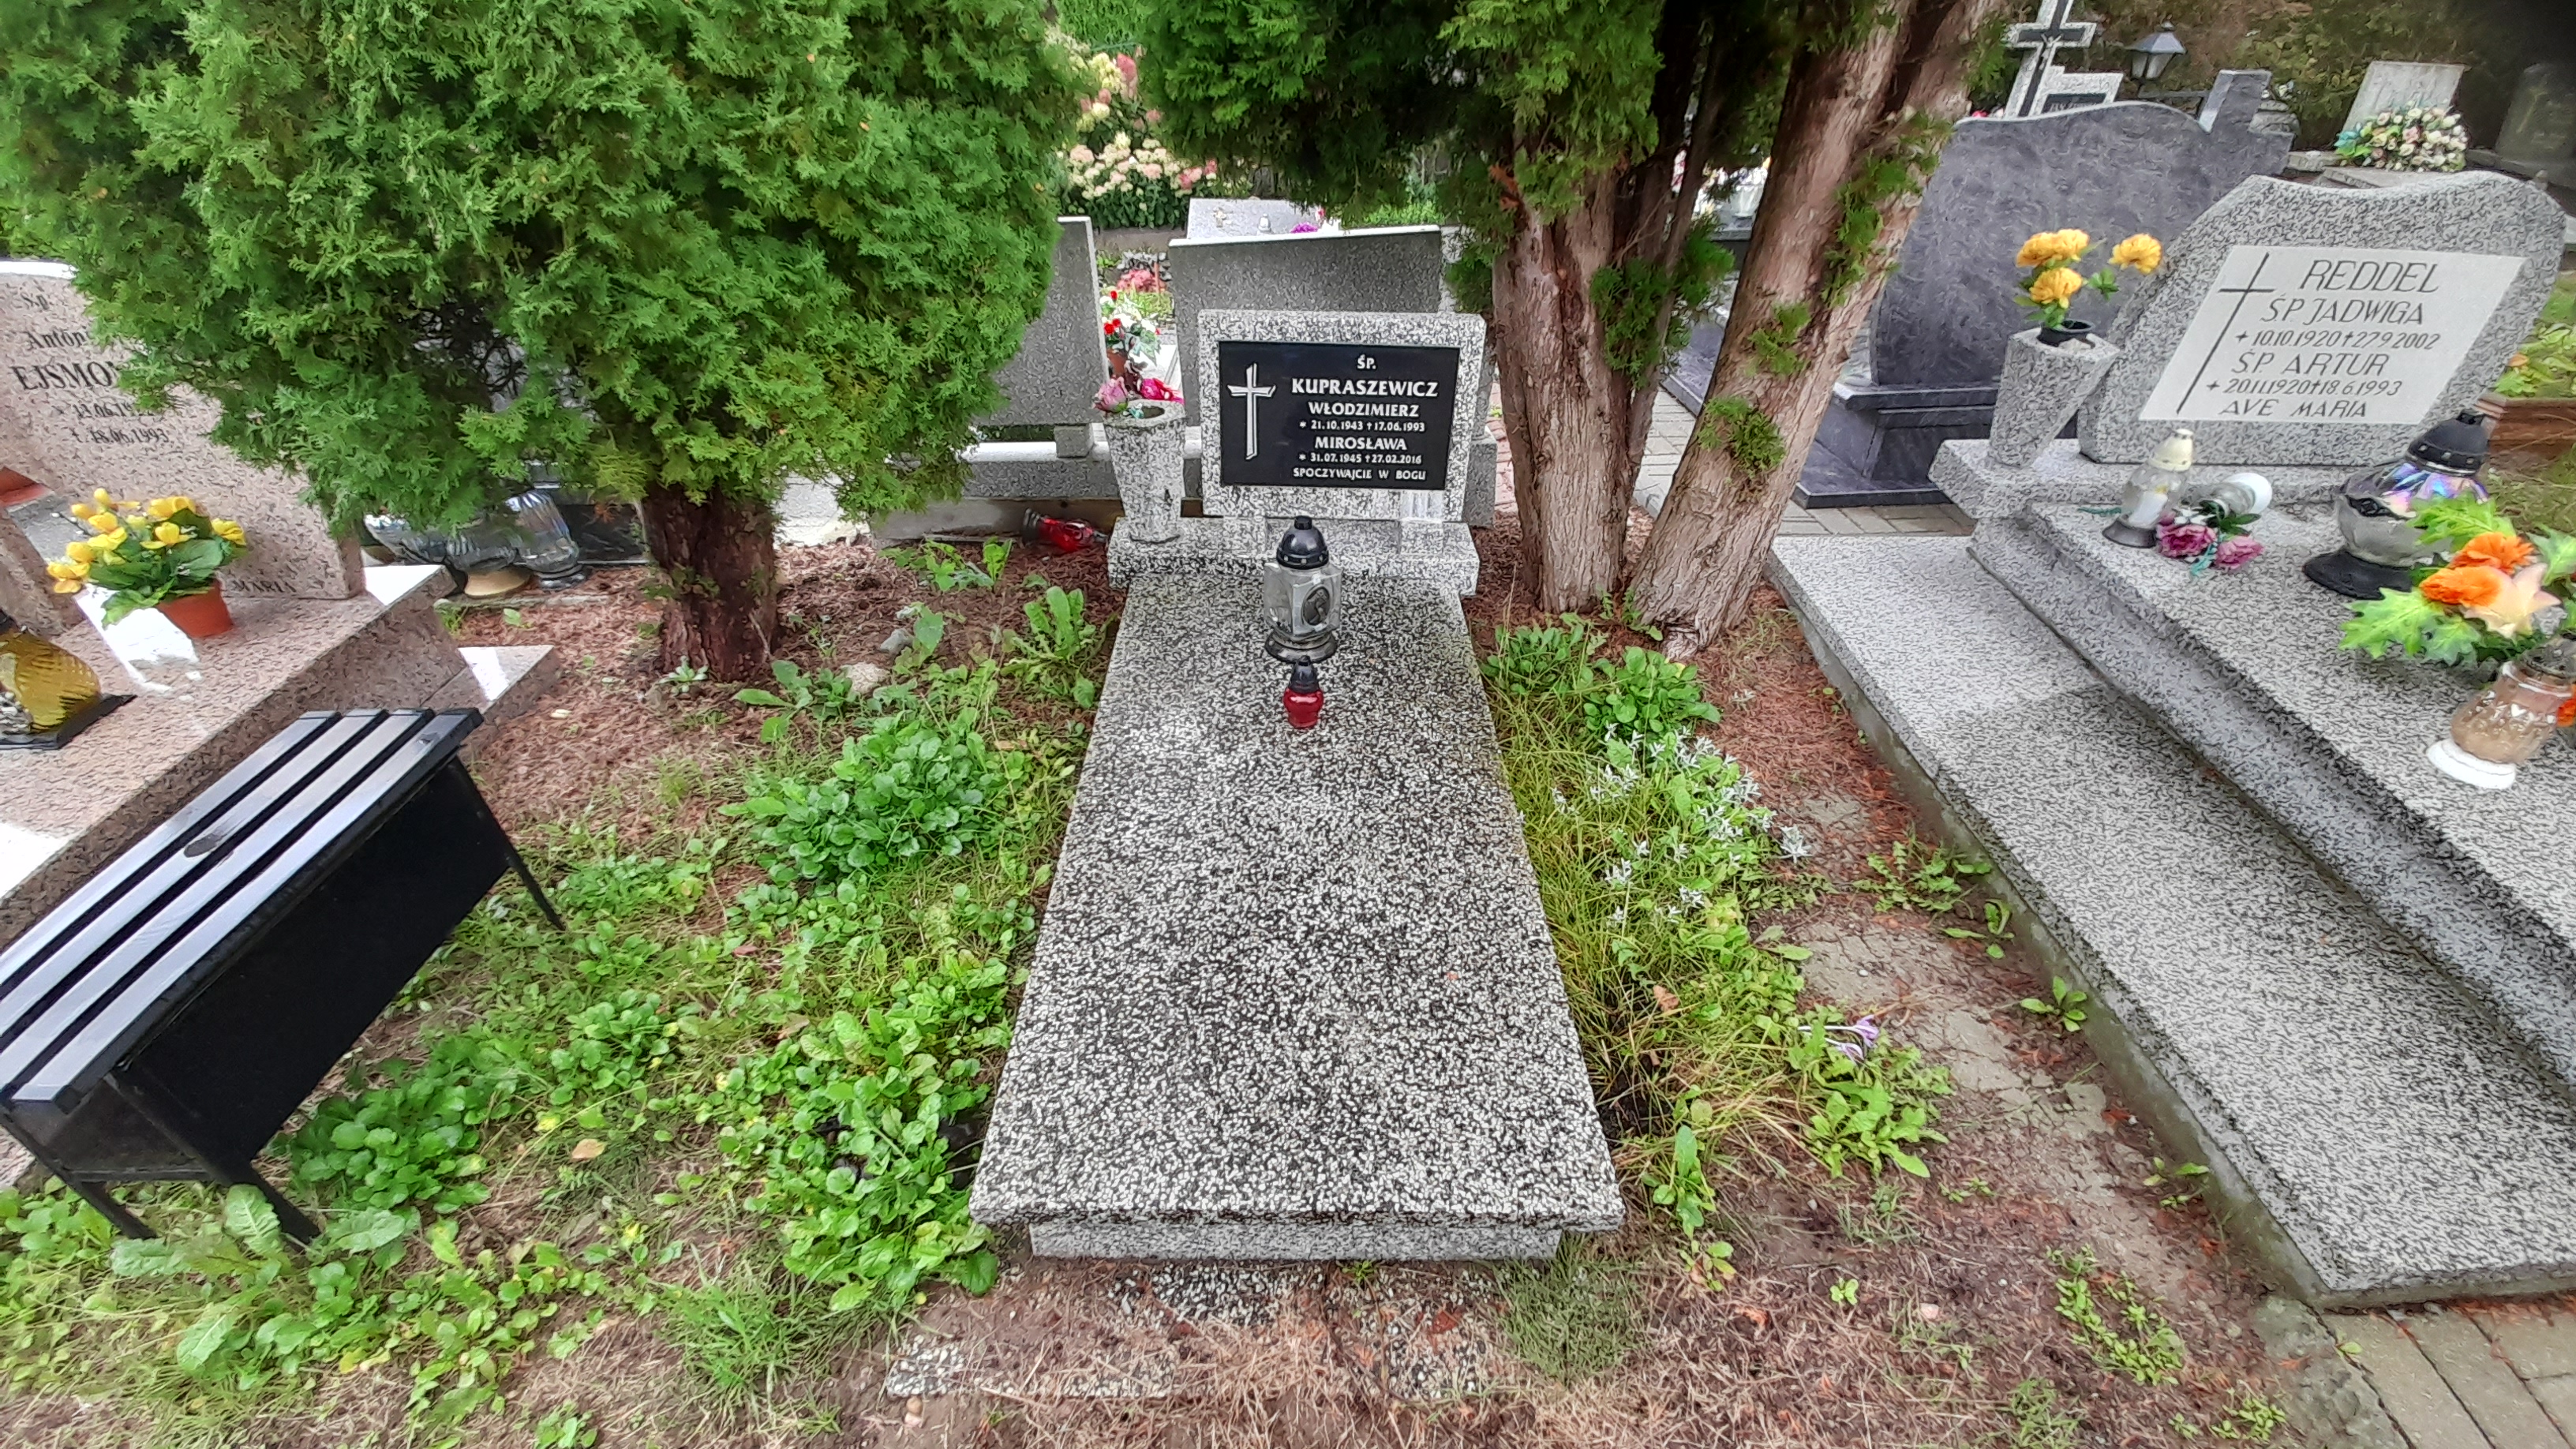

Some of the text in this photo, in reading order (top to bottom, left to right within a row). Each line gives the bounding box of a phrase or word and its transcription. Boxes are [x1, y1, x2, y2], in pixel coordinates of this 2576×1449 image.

[2298, 259, 2439, 293] REDDEL
[2302, 298, 2423, 325] JADWIGA
[23, 326, 91, 350] Anton
[2281, 352, 2390, 376] ARTUR
[1291, 377, 1439, 398] KUPRASZEWICZ
[1307, 401, 1420, 417] WŁODZIMIERZ
[2218, 399, 2368, 418] AVE MARIA
[1310, 419, 1425, 432] 21.10.1943 17.06.1993
[1314, 436, 1408, 451] MIROSŁAWA
[1309, 452, 1423, 465] 31.07.1945 27.02.2016
[1293, 467, 1427, 481] SPOCZYWAJCIE W BOGU
